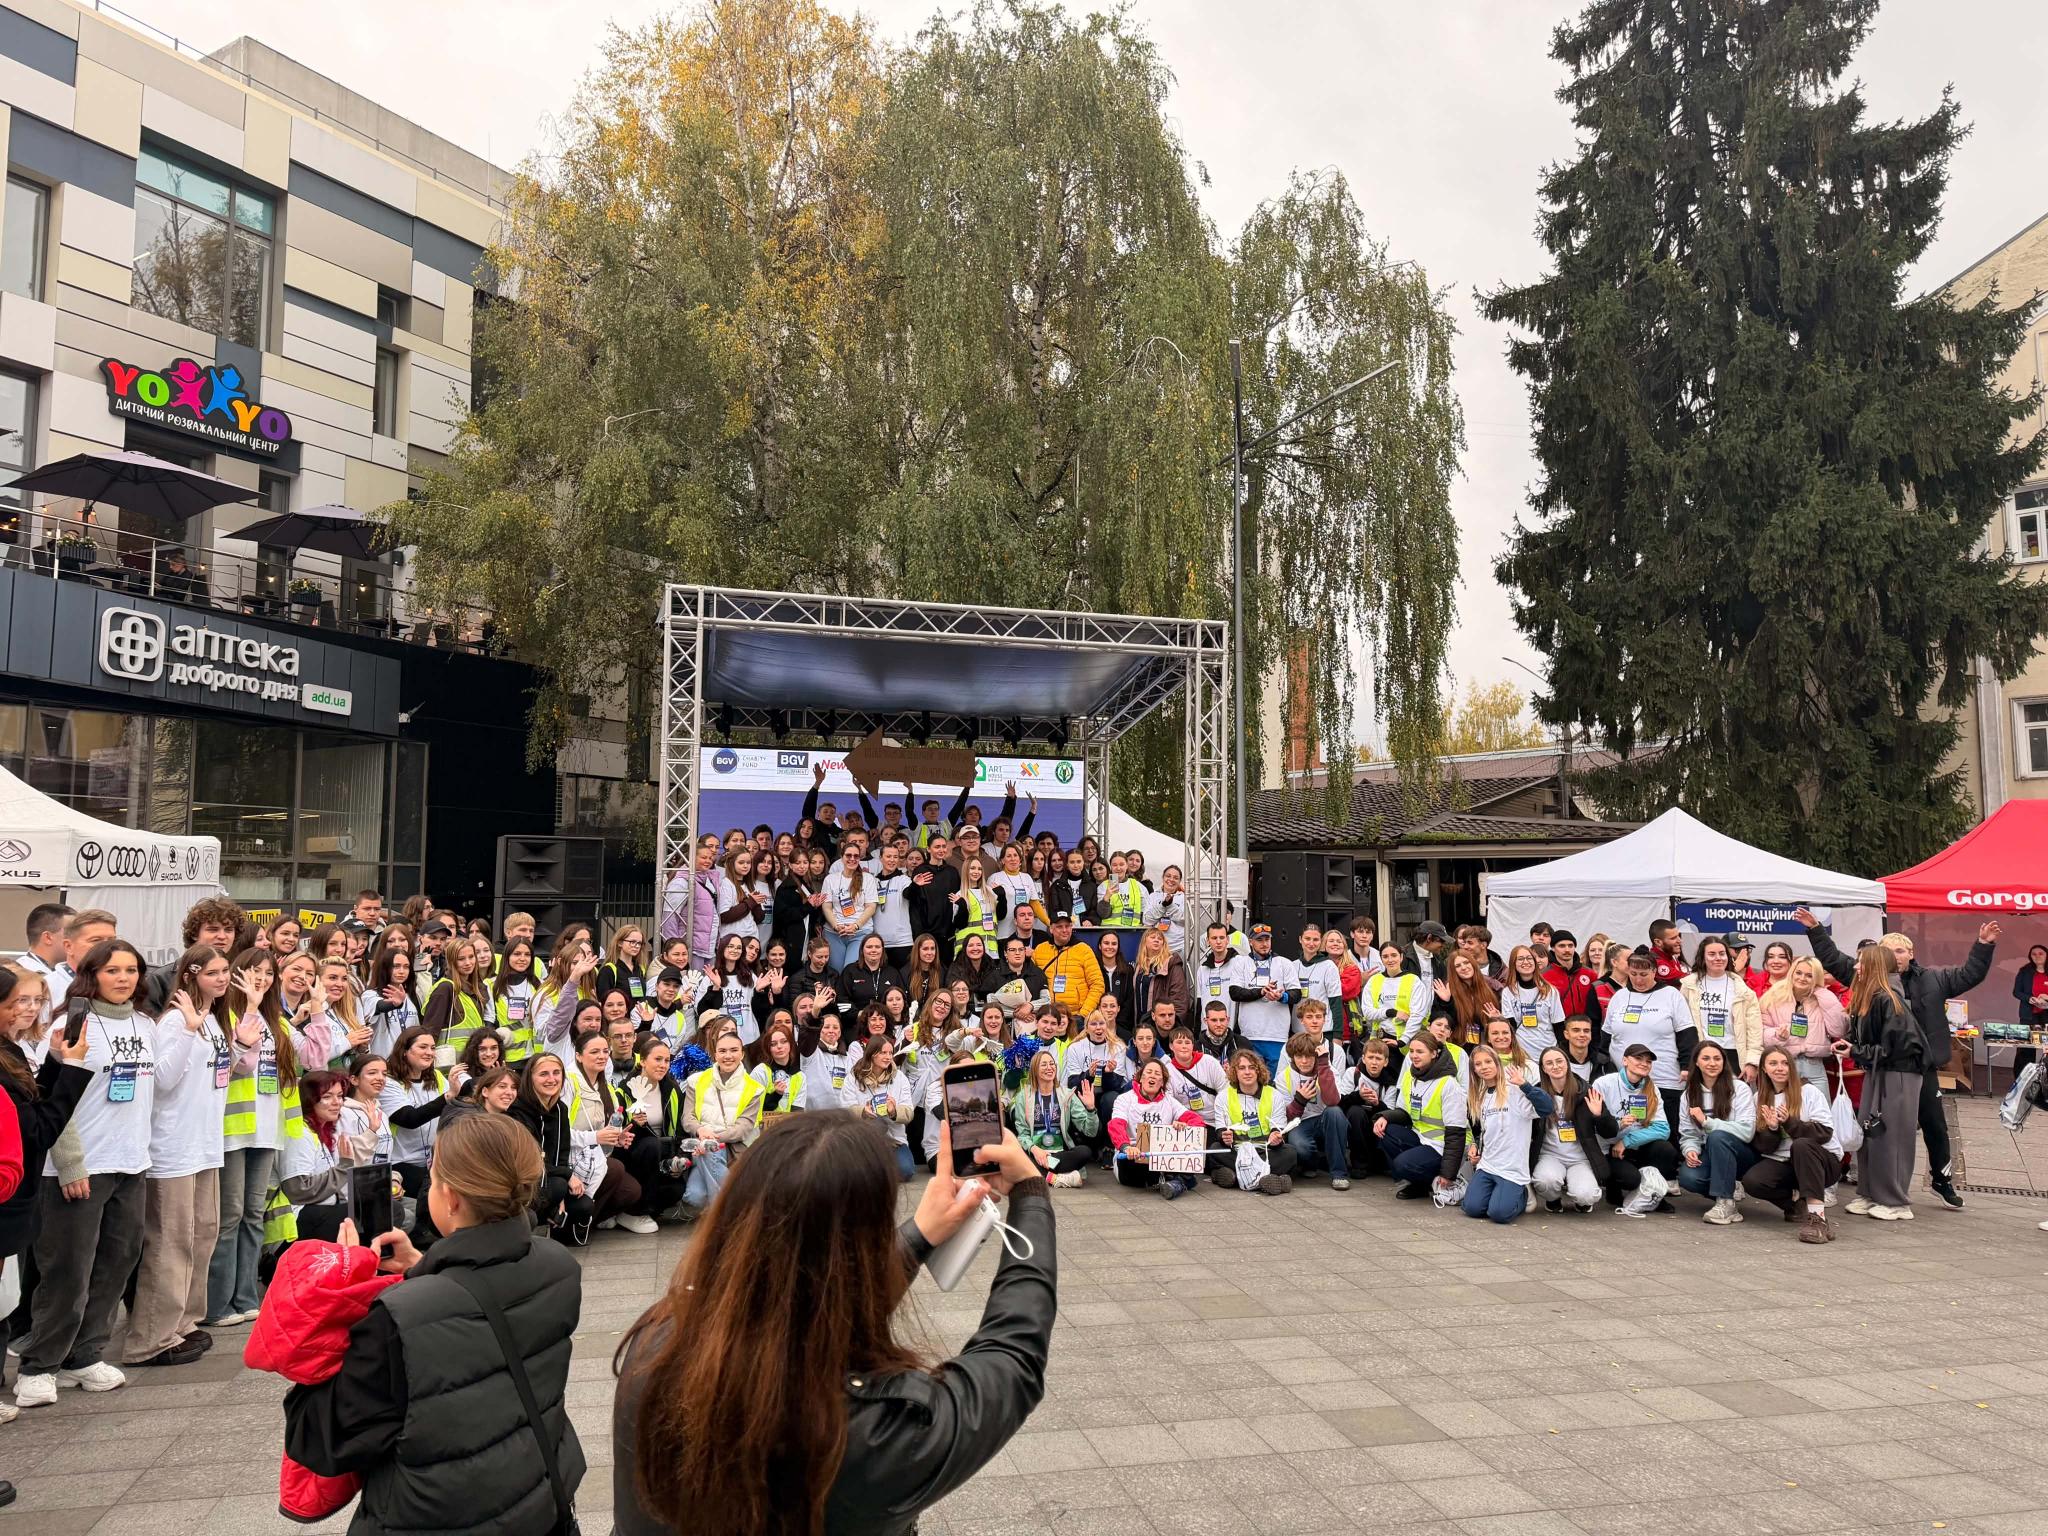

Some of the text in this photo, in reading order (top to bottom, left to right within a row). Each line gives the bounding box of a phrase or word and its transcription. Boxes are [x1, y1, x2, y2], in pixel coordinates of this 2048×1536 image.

[115, 398, 280, 453] ДИТЯЧИЙ РОЗВАЖАЛЬНИЙ ЦЕНТР
[171, 624, 300, 677] аптека
[168, 662, 299, 701] доброго дня
[311, 692, 346, 707] add.ua
[716, 757, 735, 765] BGV
[780, 754, 806, 766] BGV
[988, 765, 1003, 773] ART
[1946, 889, 2048, 910] Gorgo
[310, 913, 324, 928] 79
[1705, 908, 1796, 921] ІНФОРМАЦІЙНИ
[1736, 921, 1774, 932] ПУНКТ
[1153, 1126, 1194, 1143] ТВІЙ
[1151, 1155, 1203, 1172] НАСТАВ
